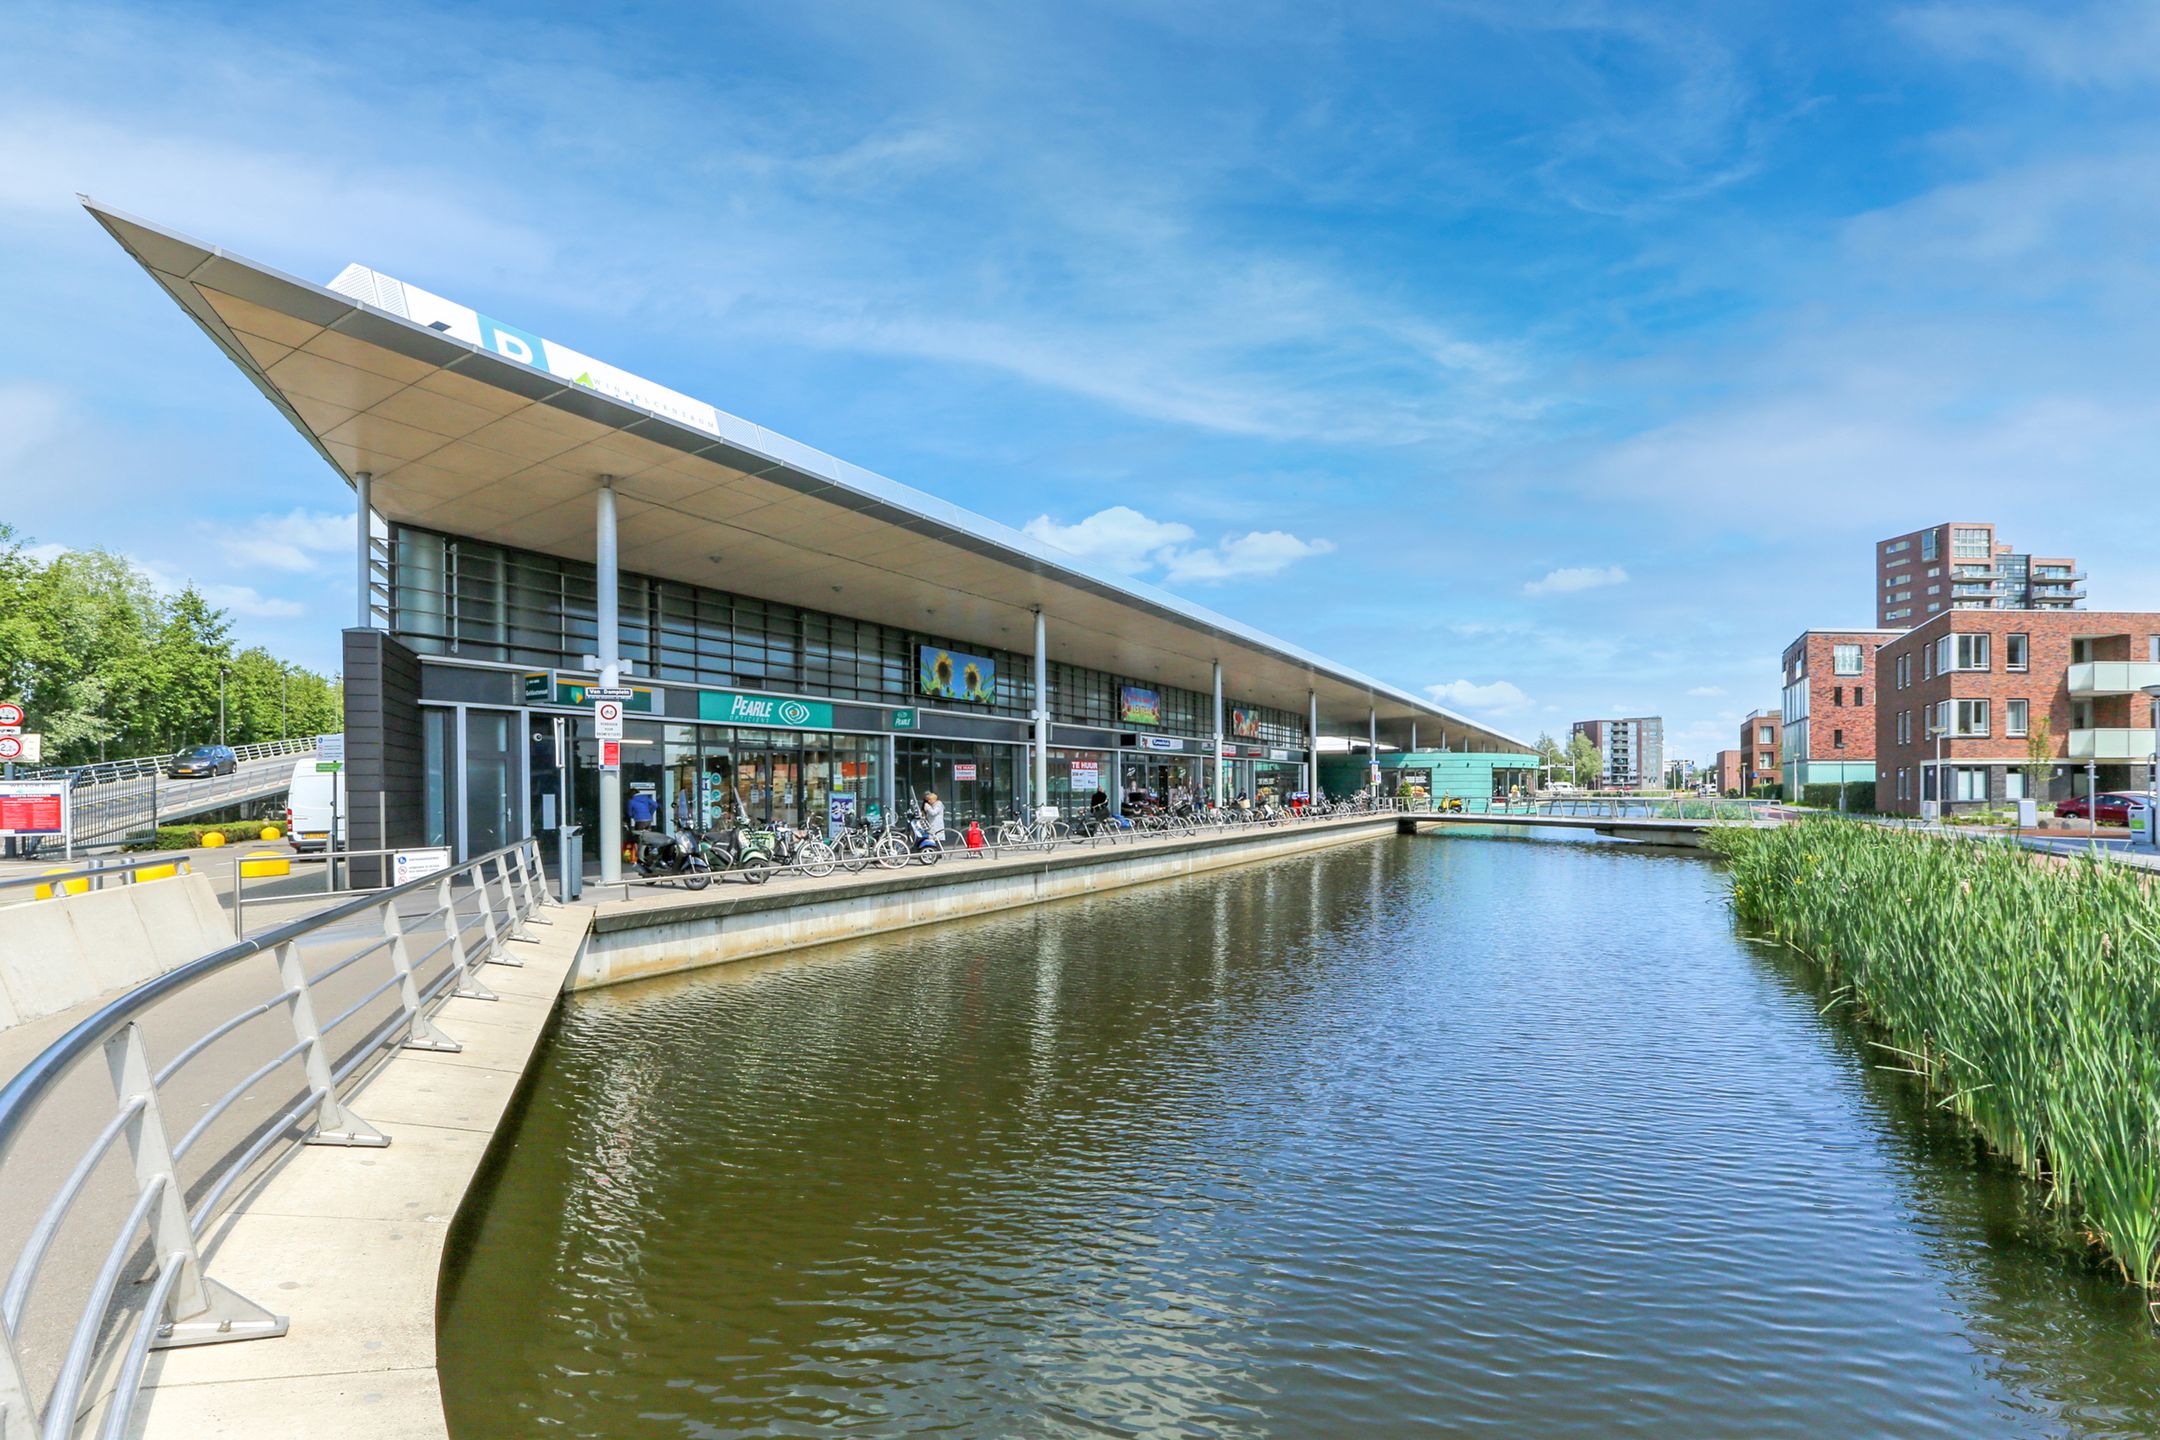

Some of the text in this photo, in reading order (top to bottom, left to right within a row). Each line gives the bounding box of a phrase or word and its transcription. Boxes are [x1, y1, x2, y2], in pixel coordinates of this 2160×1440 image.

[592, 377, 714, 428] WINKELCENTRUM
[731, 695, 773, 718] PEARLE
[1071, 761, 1080, 769] TE
